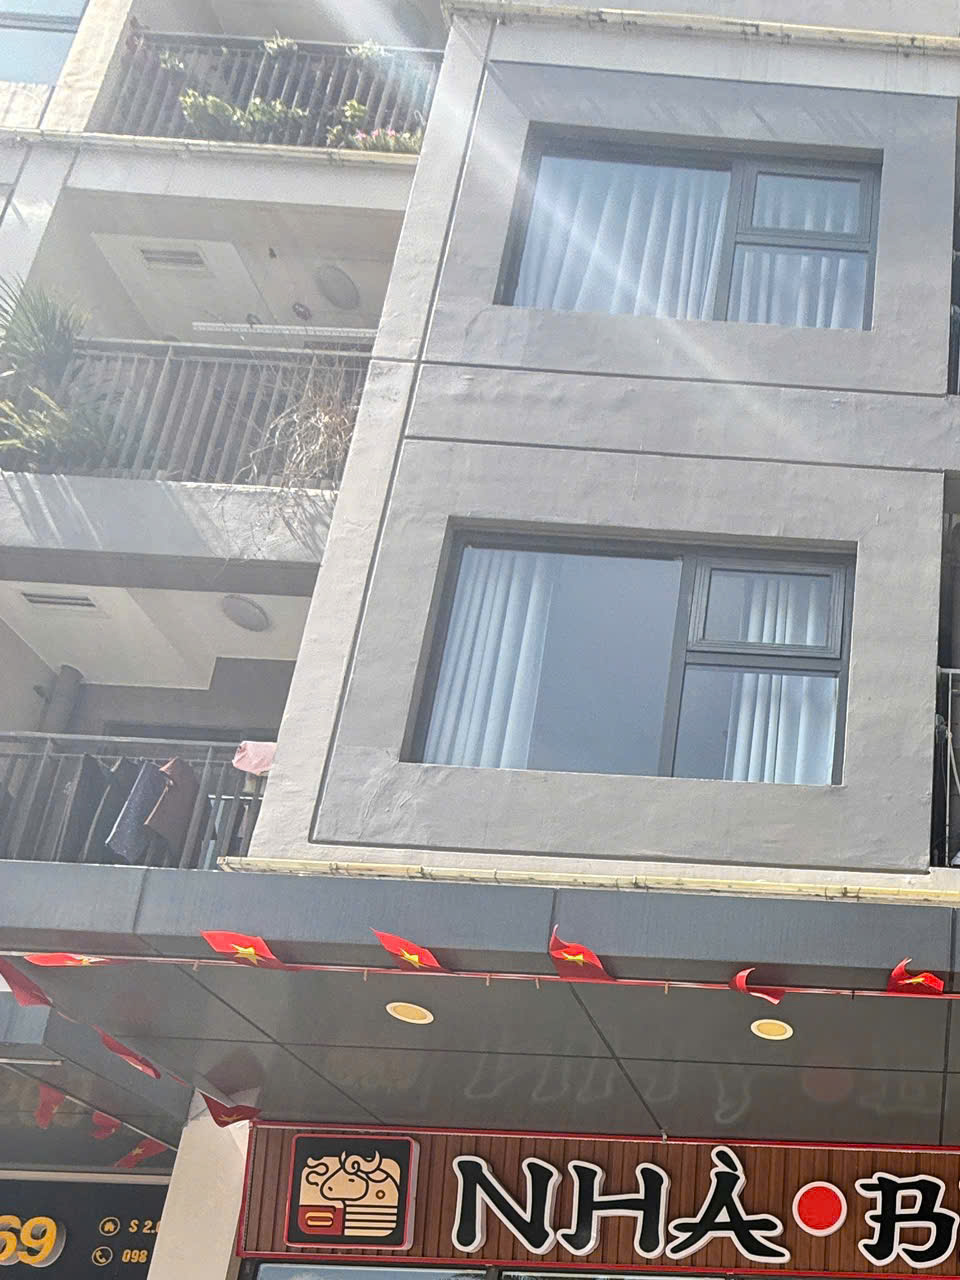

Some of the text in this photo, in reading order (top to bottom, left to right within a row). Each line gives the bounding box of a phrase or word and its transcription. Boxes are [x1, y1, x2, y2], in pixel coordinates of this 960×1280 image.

[452, 1145, 790, 1263] NHÀ
[129, 1219, 139, 1233] S
[122, 1249, 148, 1263] 098
